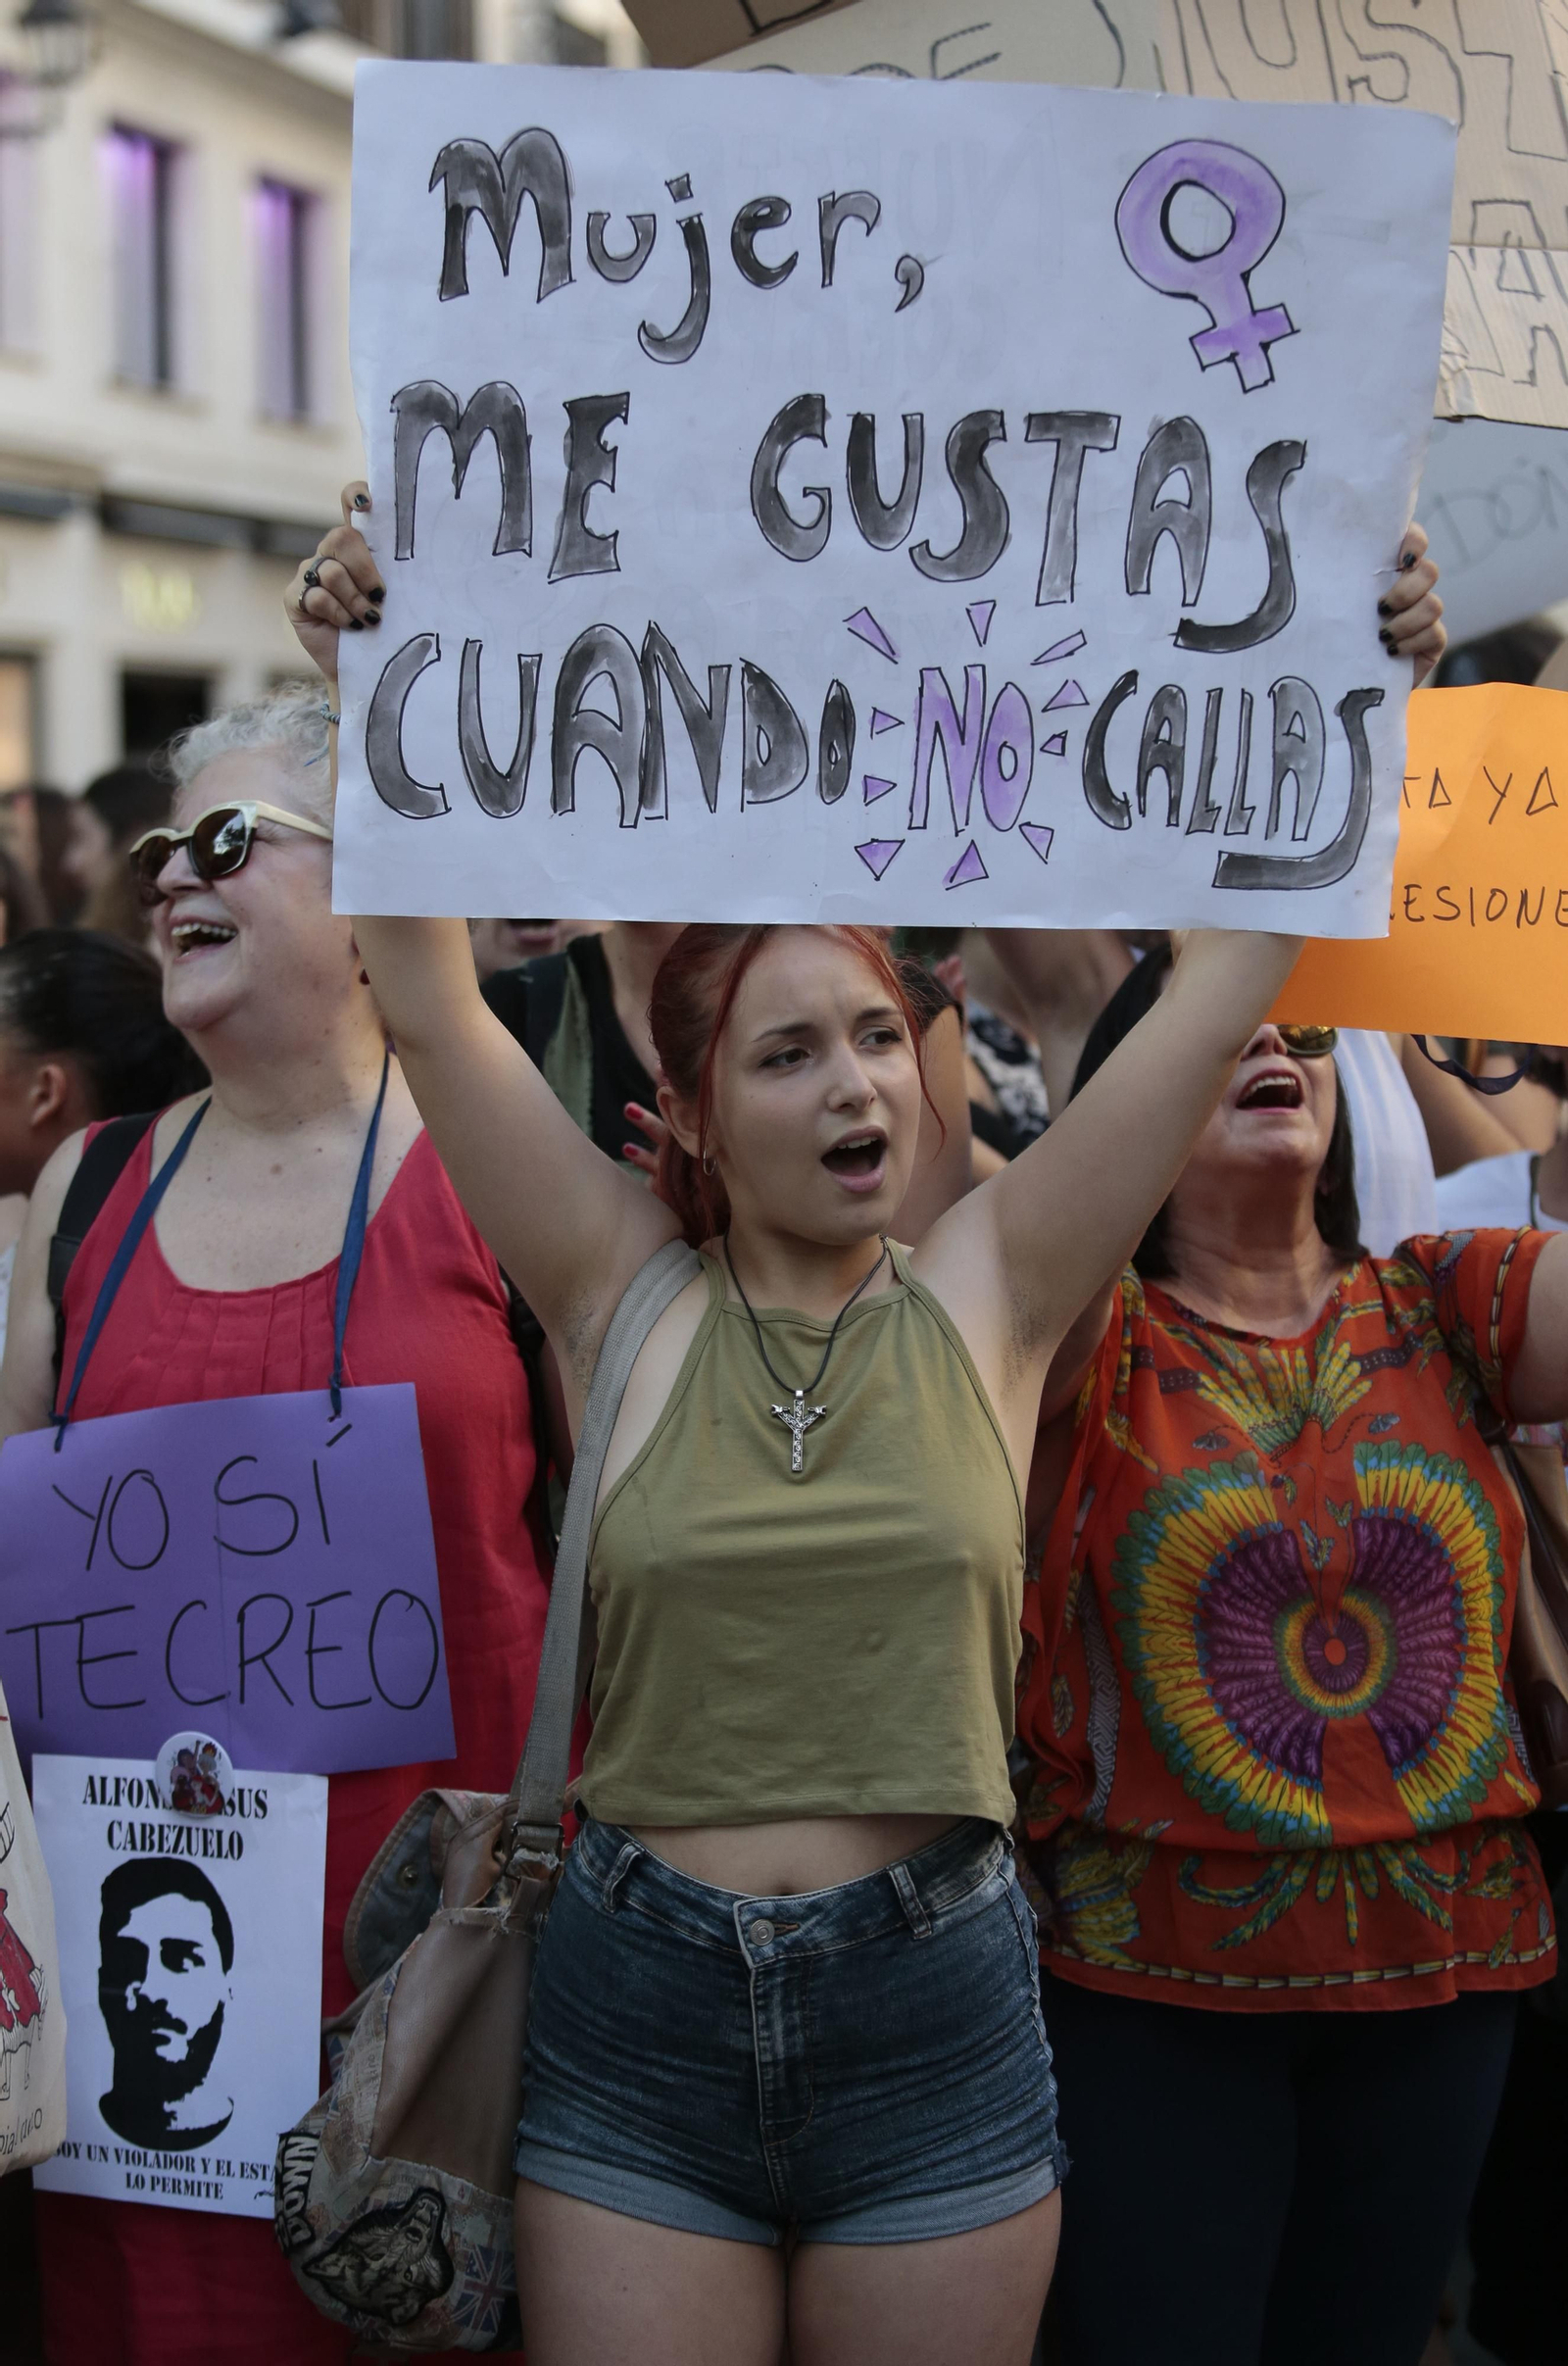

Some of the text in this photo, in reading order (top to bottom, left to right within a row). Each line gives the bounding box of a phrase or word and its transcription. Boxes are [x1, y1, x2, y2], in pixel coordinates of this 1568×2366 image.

[429, 126, 924, 364] Mujer,
[391, 380, 1307, 653] ME GUSTAS
[366, 621, 1385, 890] CUANDO NO CALLAS
[1390, 883, 1568, 929] ESIONE
[52, 1423, 352, 1571] YO SÍ
[107, 1819, 245, 1861] CABEZUELO
[87, 2144, 109, 2163] UN
[114, 2147, 197, 2173] VIOLADOR
[200, 2157, 212, 2175] Y
[216, 2159, 236, 2178] EL
[125, 2172, 224, 2200] LO PERMITE
